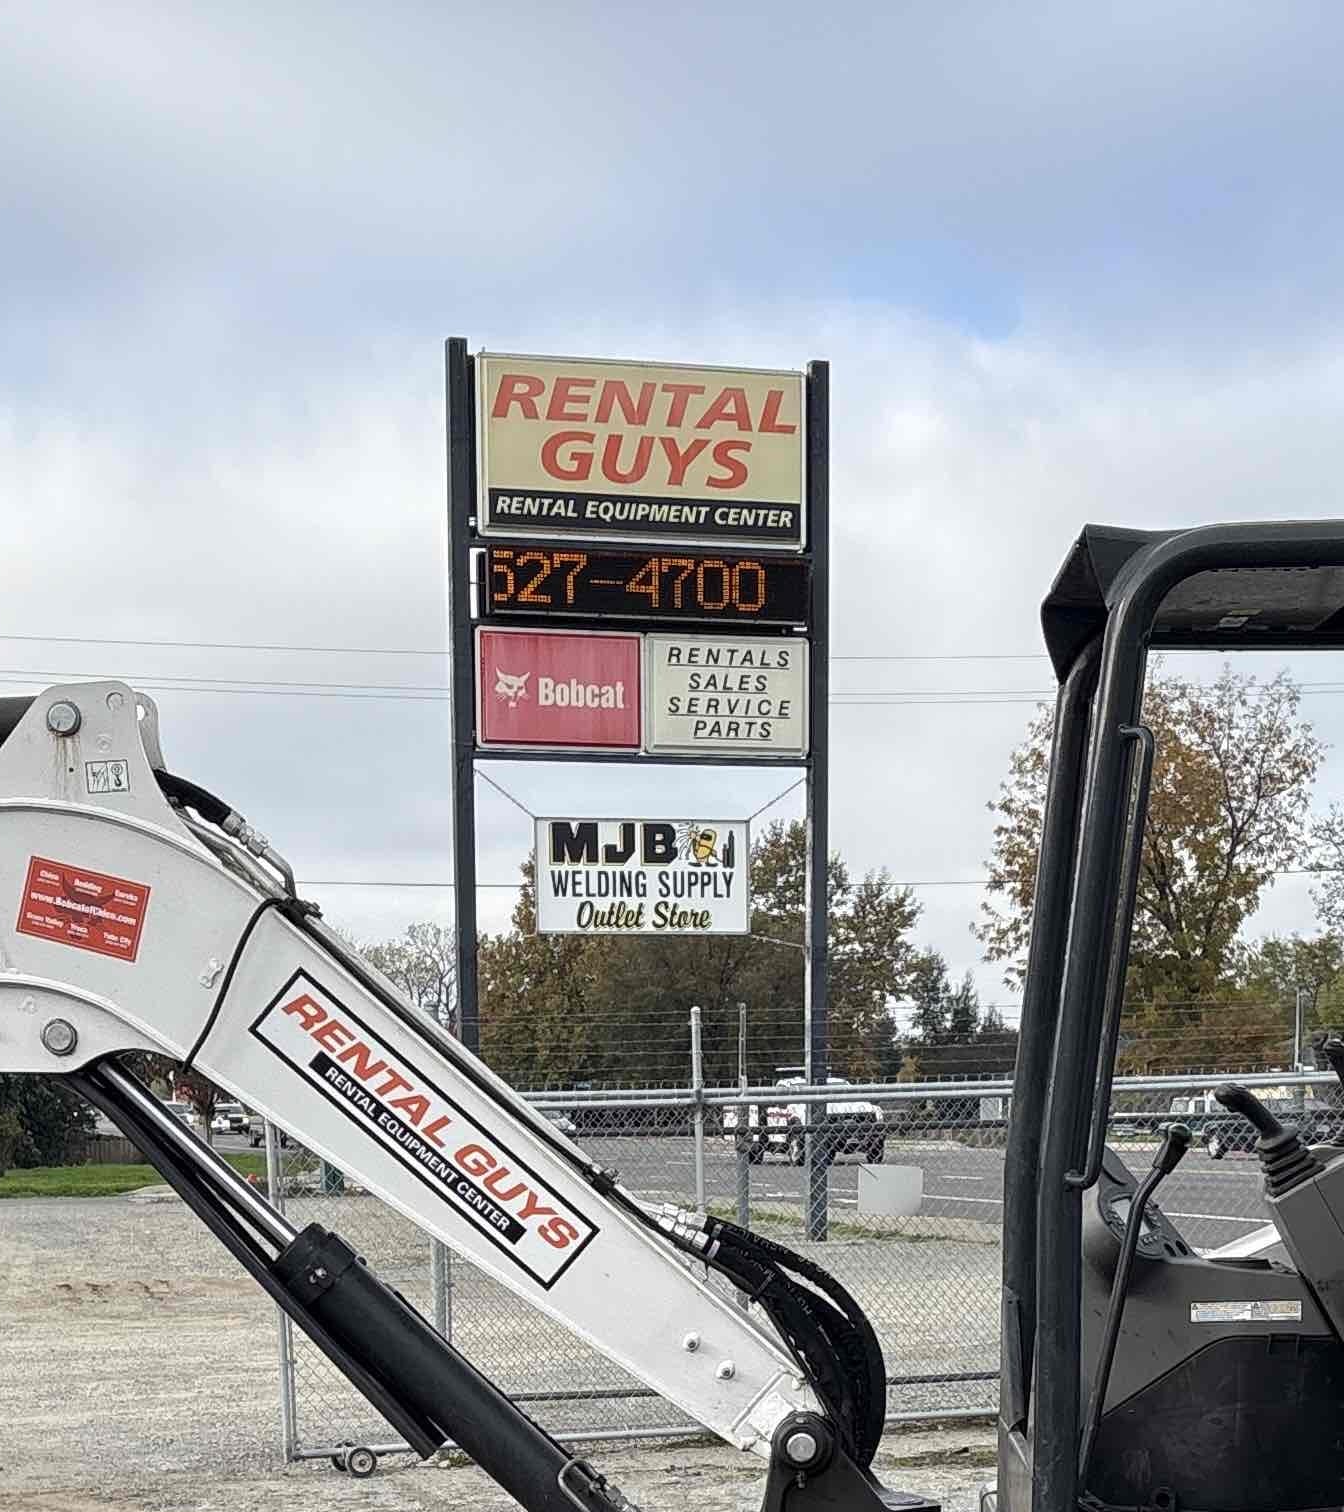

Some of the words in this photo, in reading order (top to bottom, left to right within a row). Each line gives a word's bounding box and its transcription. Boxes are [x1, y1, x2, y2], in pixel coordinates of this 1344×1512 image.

[491, 374, 797, 434] RENTAL
[540, 431, 753, 489] GUYS
[495, 495, 578, 519] RENTAL
[585, 500, 710, 524] EQUIPMENT
[714, 507, 793, 528] CENTER
[493, 550, 767, 613] 527-4700
[667, 646, 790, 667] RENTALS
[538, 677, 625, 709] Bobcat
[688, 673, 768, 692] SALES
[668, 697, 792, 717] SERVICE
[693, 721, 773, 739] PARTS
[548, 822, 680, 866] MJB
[551, 870, 647, 898] WELDING
[658, 870, 734, 898] SUPPLY
[576, 900, 645, 929] Outlet
[652, 900, 712, 929] Store
[282, 993, 452, 1148] RENTAL
[454, 1143, 579, 1249] GUYS
[325, 1067, 378, 1118] RENTAL
[377, 1112, 459, 1184] EQUIPMENT
[456, 1181, 511, 1232] CENTER
